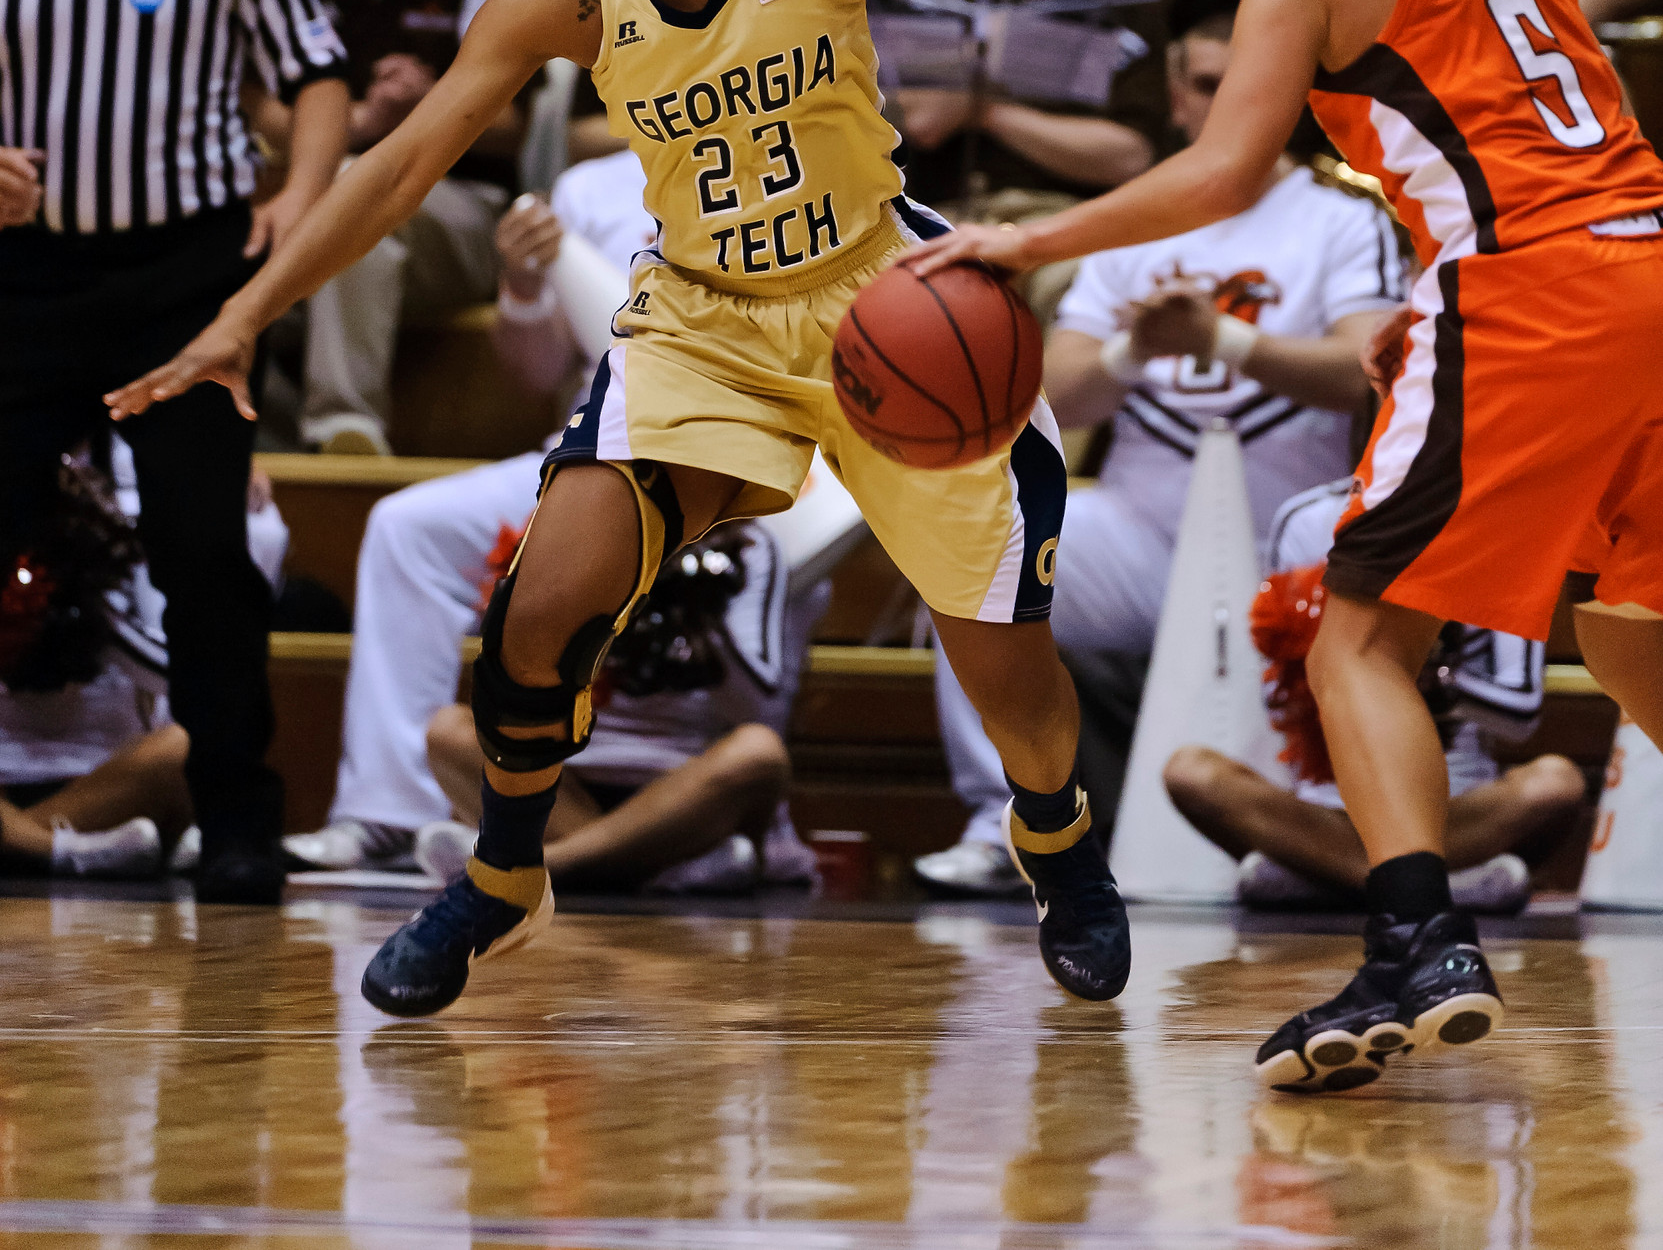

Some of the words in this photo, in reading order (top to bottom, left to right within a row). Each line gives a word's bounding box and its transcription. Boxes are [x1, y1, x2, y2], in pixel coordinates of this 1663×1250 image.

[619, 21, 636, 39] R
[614, 35, 645, 48] RUSSELL
[626, 34, 836, 143] GEORGIA
[691, 121, 804, 219] 23
[710, 191, 842, 275] TECH
[633, 291, 650, 308] R
[628, 306, 651, 315] RUSSELL
